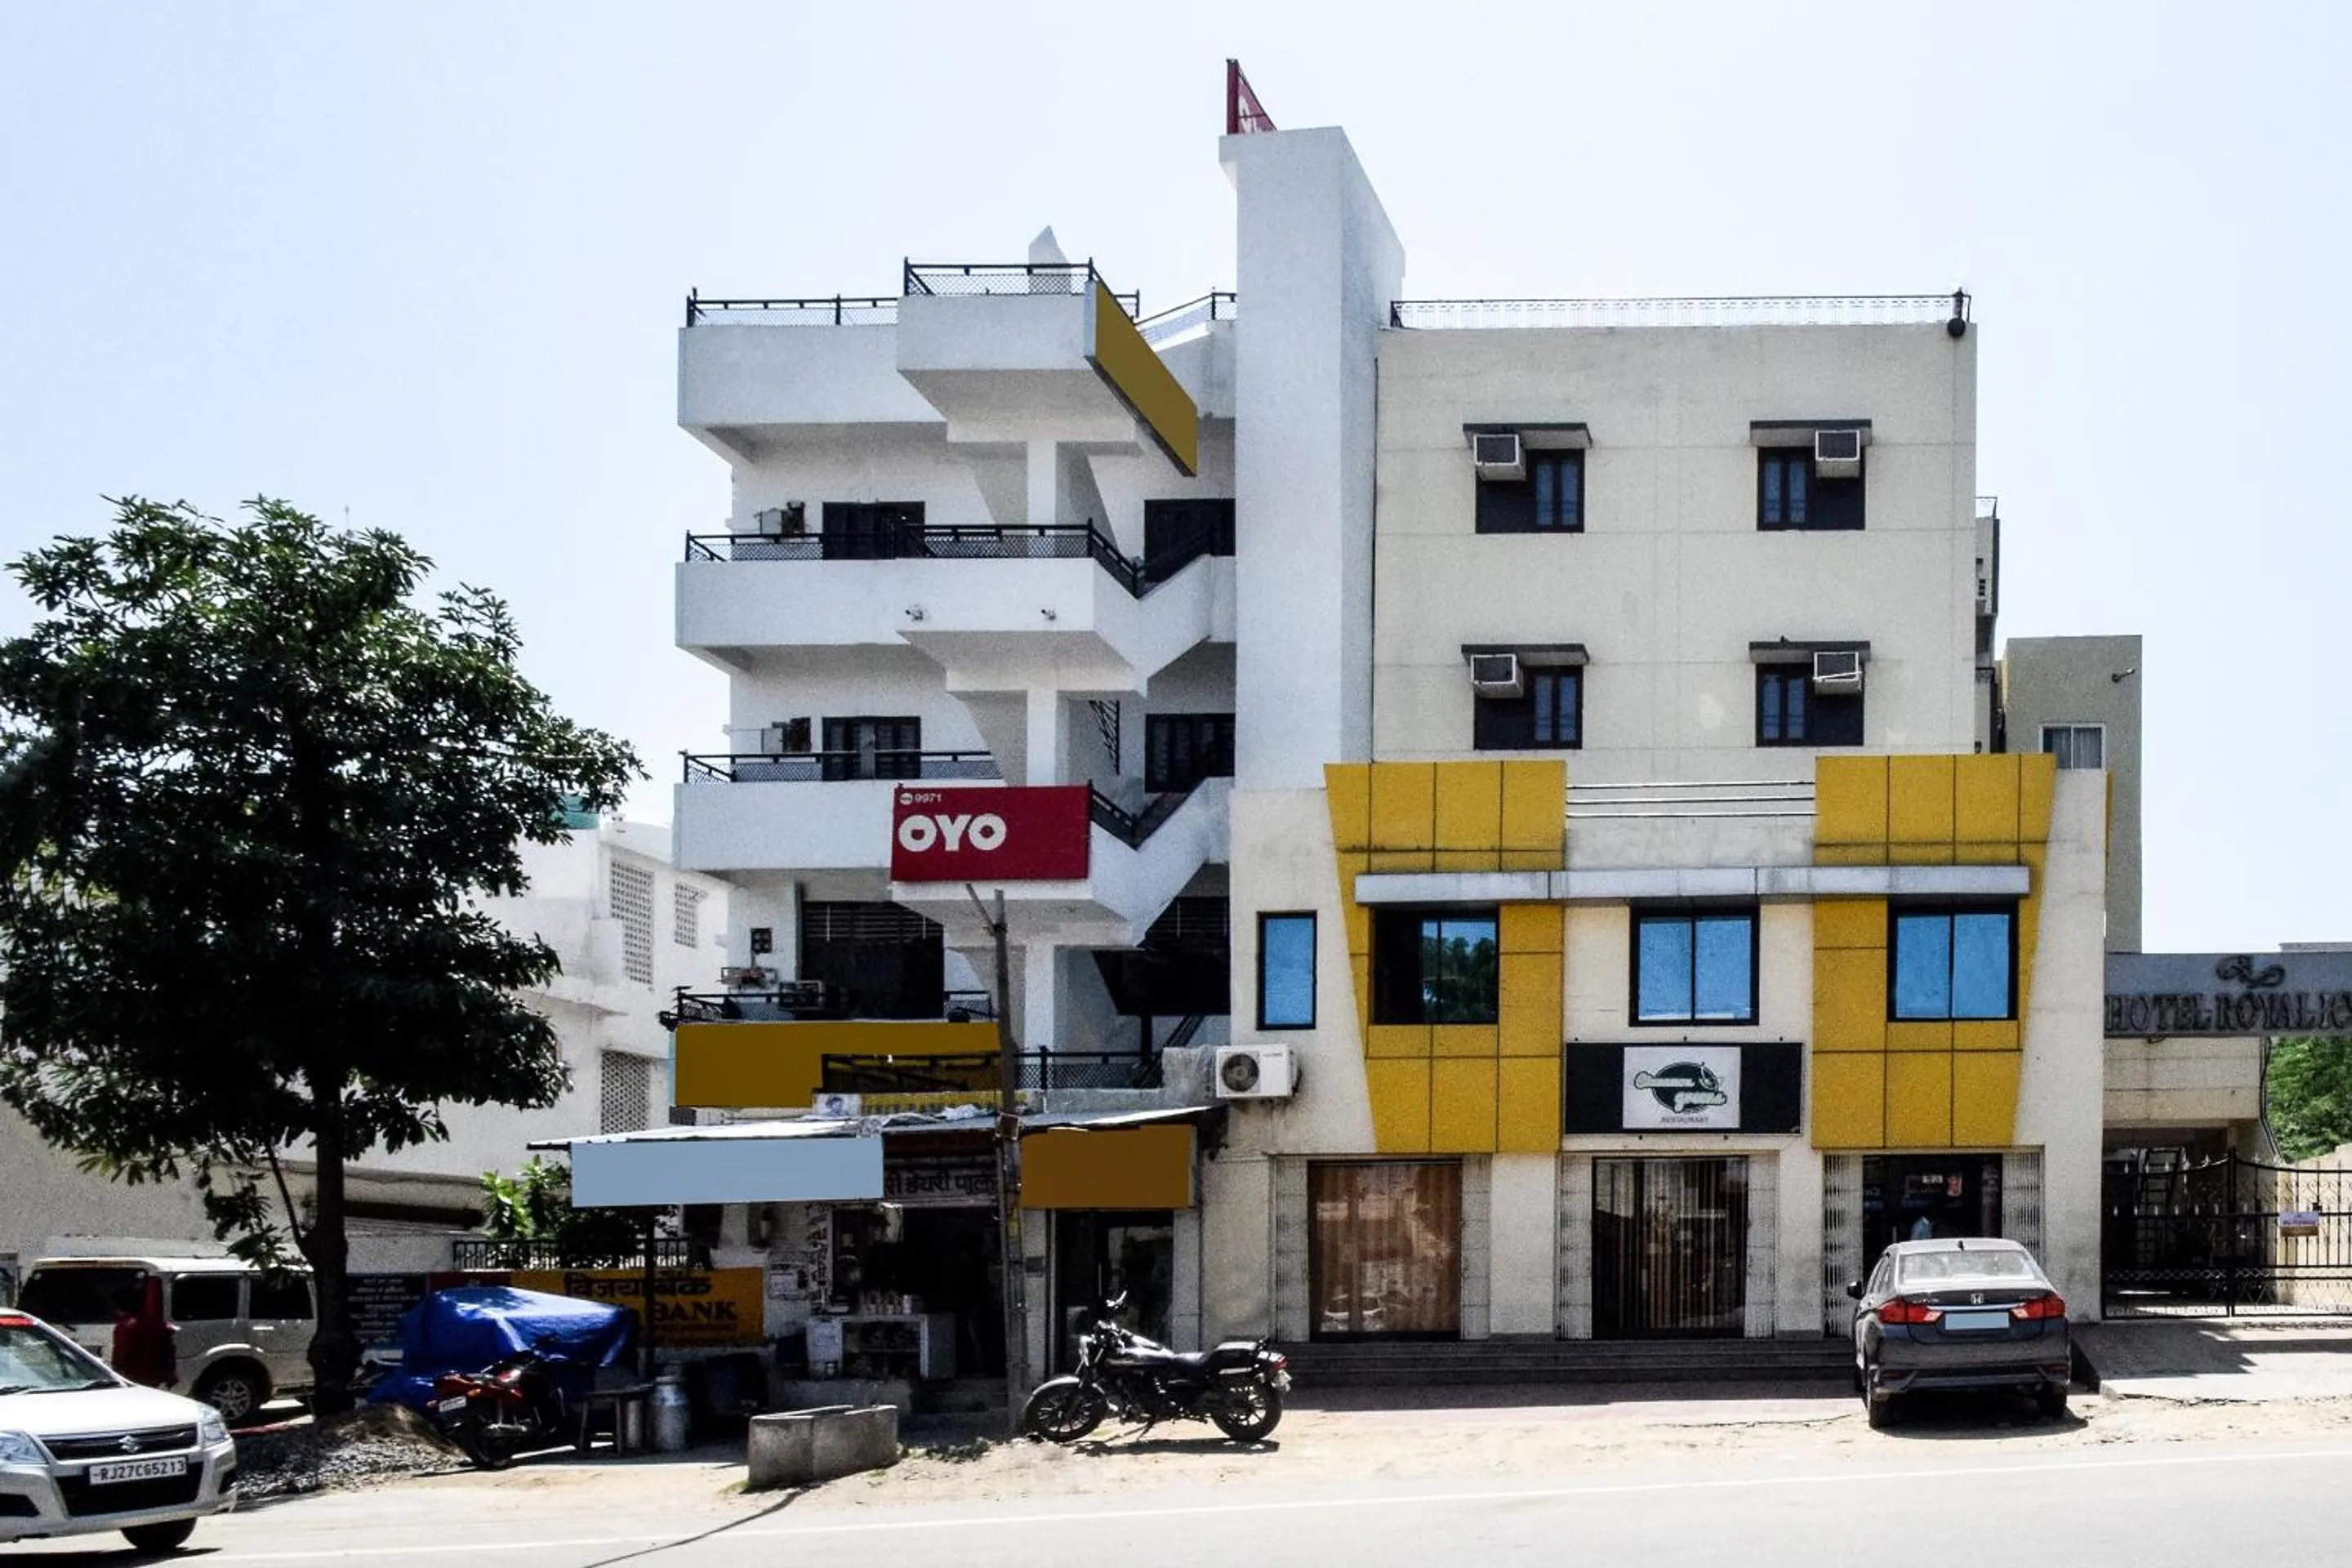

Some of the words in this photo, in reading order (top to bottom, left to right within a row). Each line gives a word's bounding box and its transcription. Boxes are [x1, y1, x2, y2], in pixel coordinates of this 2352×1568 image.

[898, 813, 1007, 852] OYO
[2105, 993, 2210, 1031] HOTEL
[2214, 991, 2316, 1030] ROYAL
[653, 1300, 738, 1321] BANK
